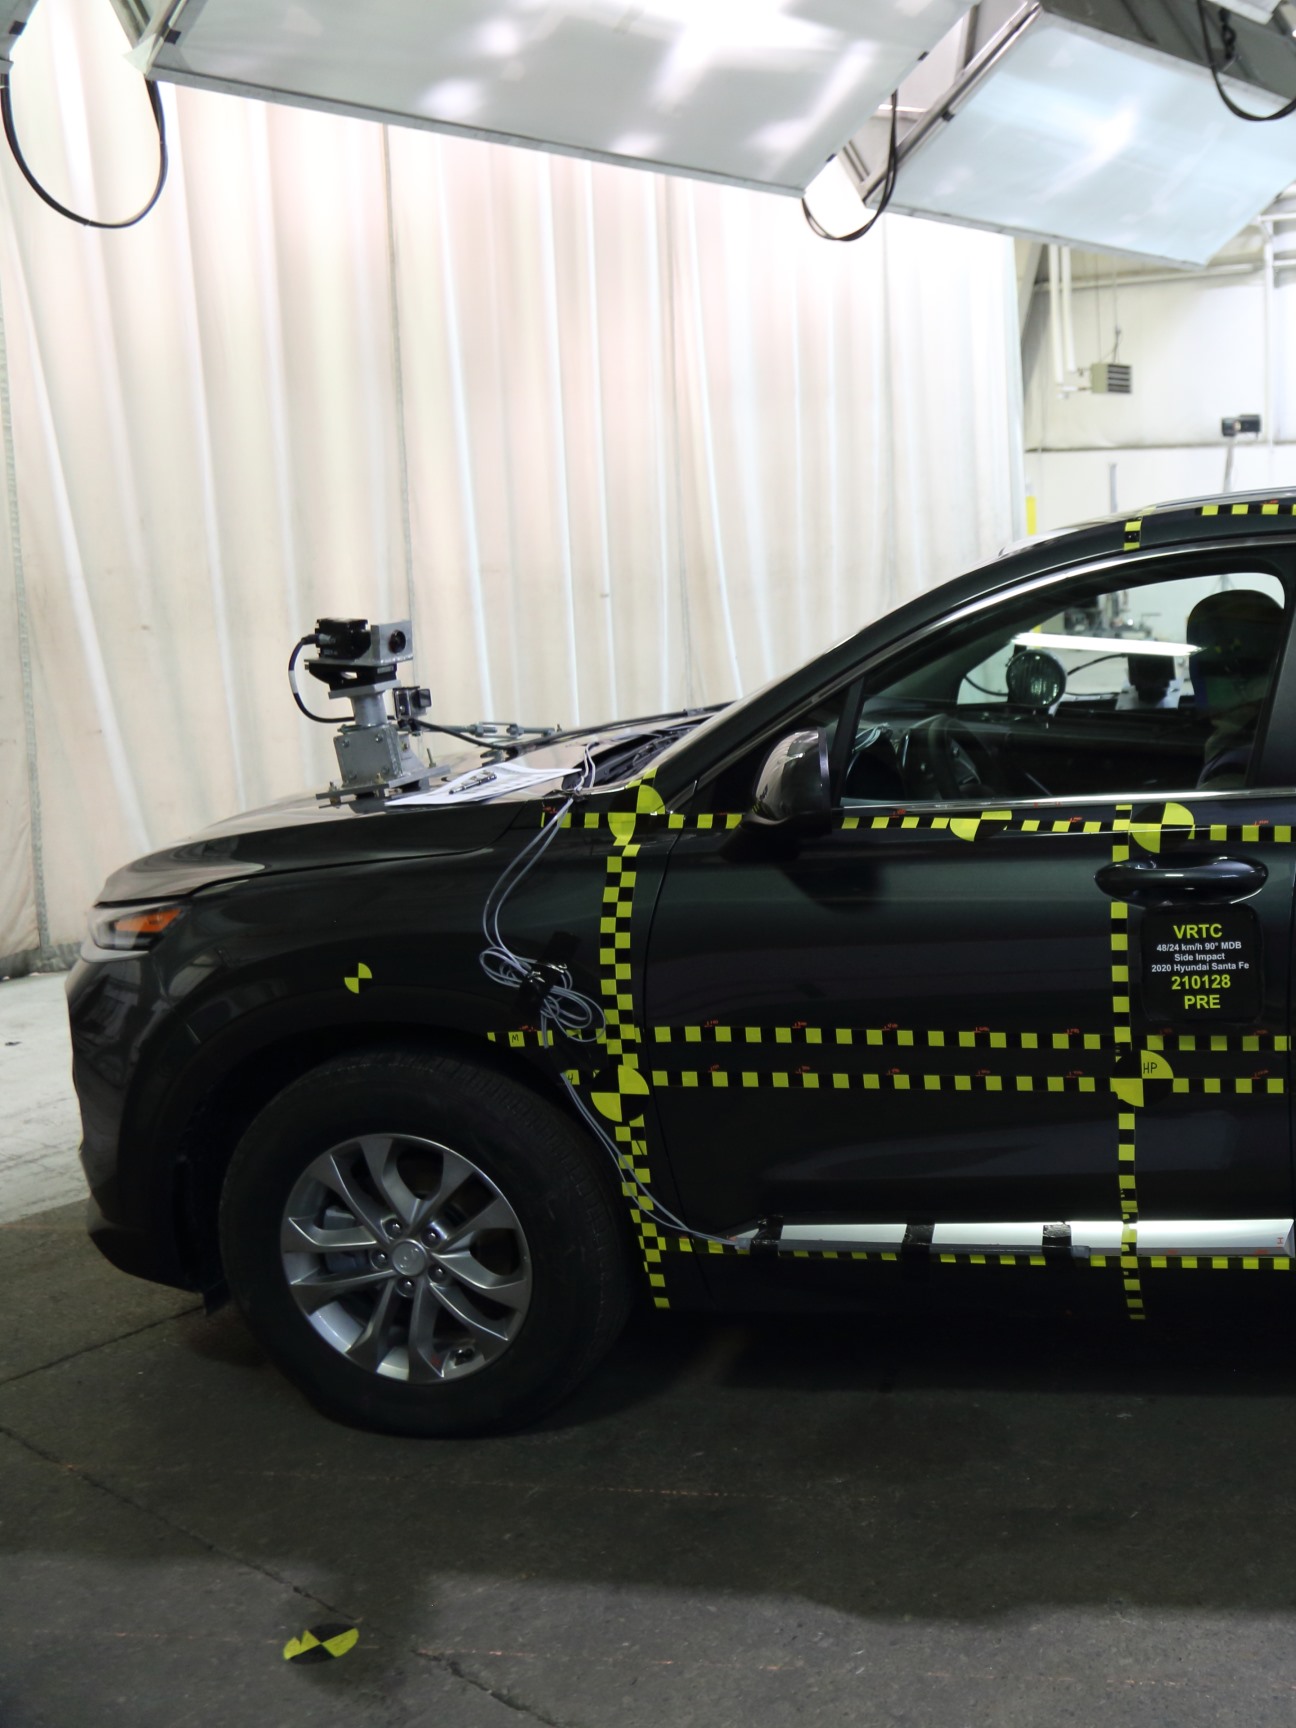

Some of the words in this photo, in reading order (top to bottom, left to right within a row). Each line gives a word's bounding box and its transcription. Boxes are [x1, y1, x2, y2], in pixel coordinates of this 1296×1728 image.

[1173, 924, 1223, 940] VRTC
[1156, 944, 1180, 952] 48/24
[1181, 943, 1203, 952] km/h
[1221, 942, 1242, 950] MDB
[1174, 954, 1194, 962] Side
[1195, 953, 1226, 963] Impact
[1151, 965, 1172, 973] 2020
[1173, 964, 1210, 974] Hyundai
[1211, 963, 1237, 971] Santa
[1238, 962, 1250, 970] Fe
[1171, 975, 1231, 990] 210128
[1183, 995, 1221, 1010] PRE
[1142, 1062, 1158, 1074] HP
